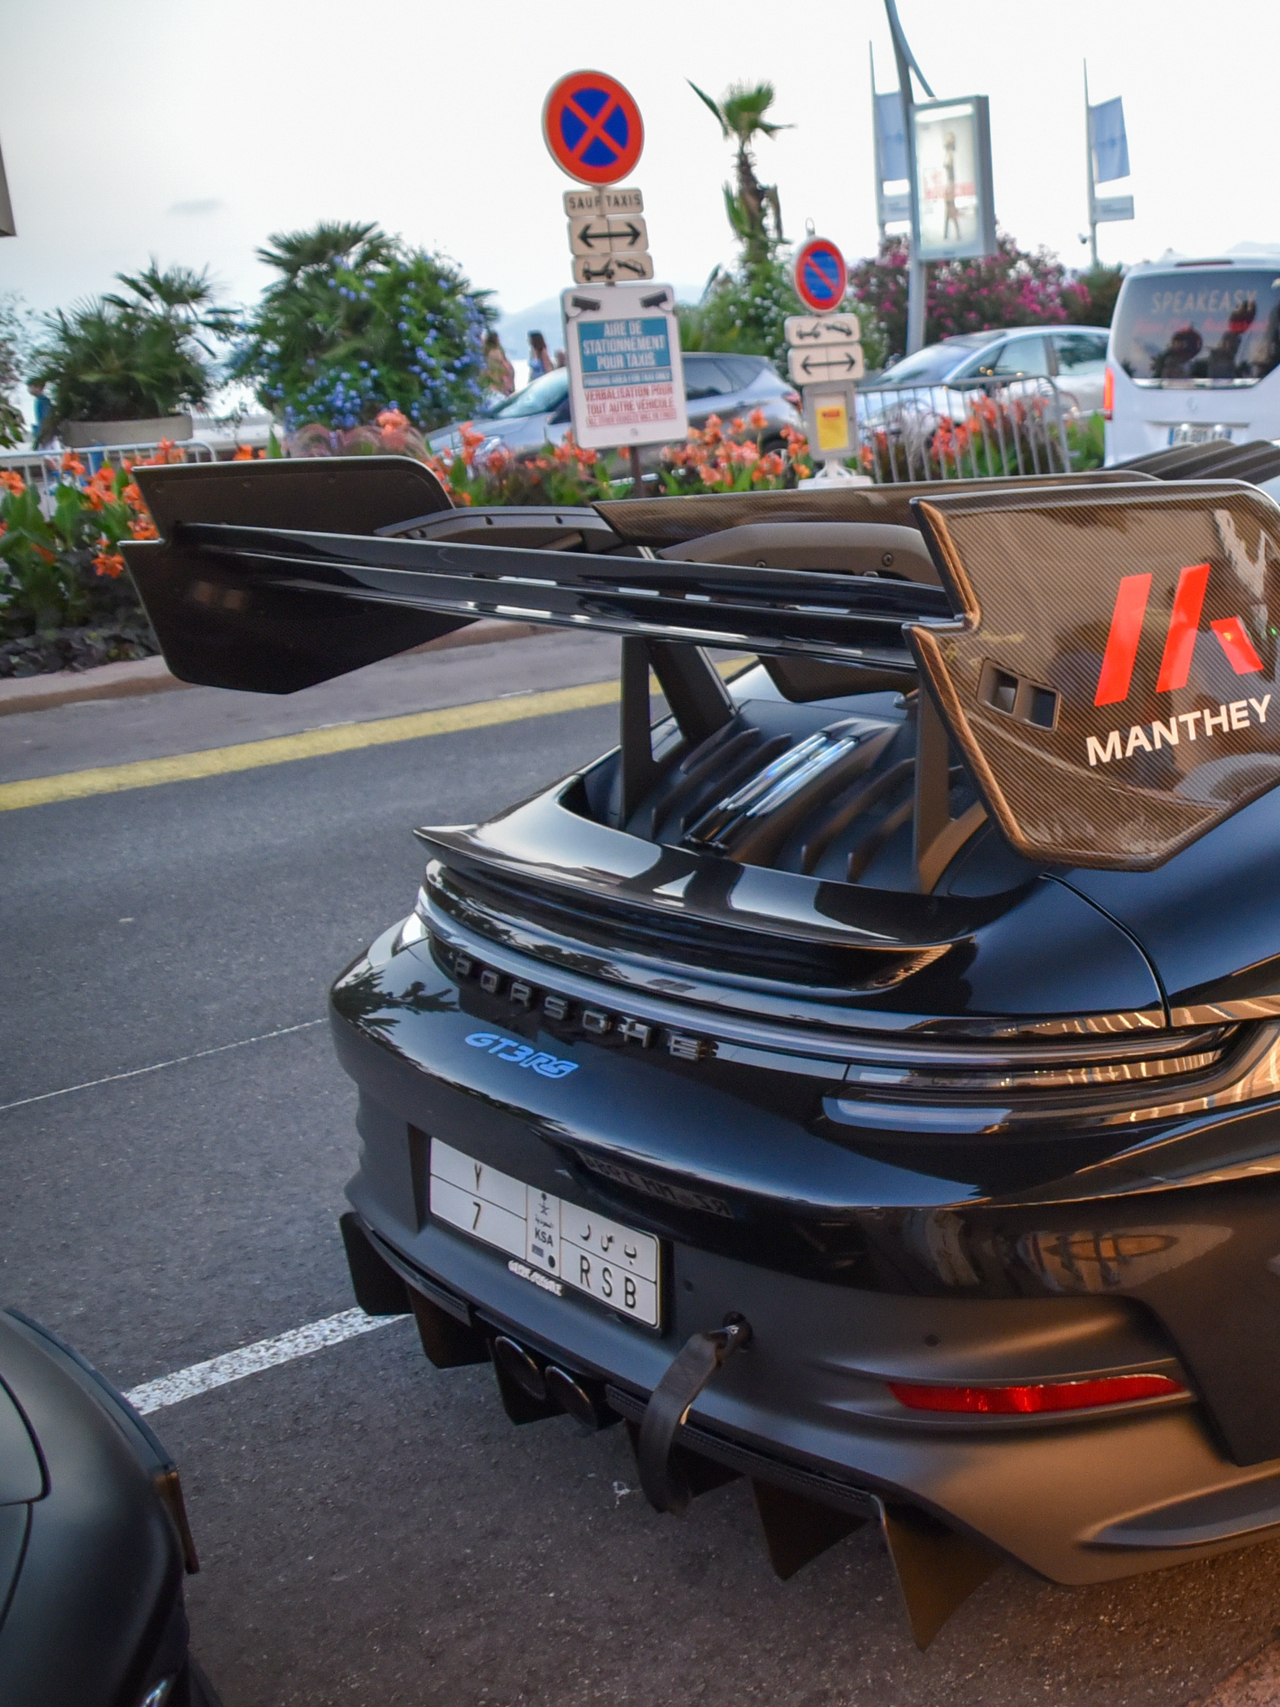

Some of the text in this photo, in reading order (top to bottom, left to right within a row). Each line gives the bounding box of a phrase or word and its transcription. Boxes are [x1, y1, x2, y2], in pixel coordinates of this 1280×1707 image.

[568, 193, 641, 210] SAUF TAXIS
[1152, 289, 1257, 314] SPEAKEASY
[604, 320, 642, 337] AIRE DE
[583, 335, 666, 355] STATIONNEMENT
[597, 351, 656, 371] POUR TAXIS
[585, 382, 673, 402] VERBALISATION POUR
[587, 402, 606, 416] TOUT
[1086, 694, 1272, 767] MANTHEY
[454, 957, 702, 1062] PORSCHE
[472, 1201, 482, 1230] 7
[534, 1227, 554, 1247] KSA
